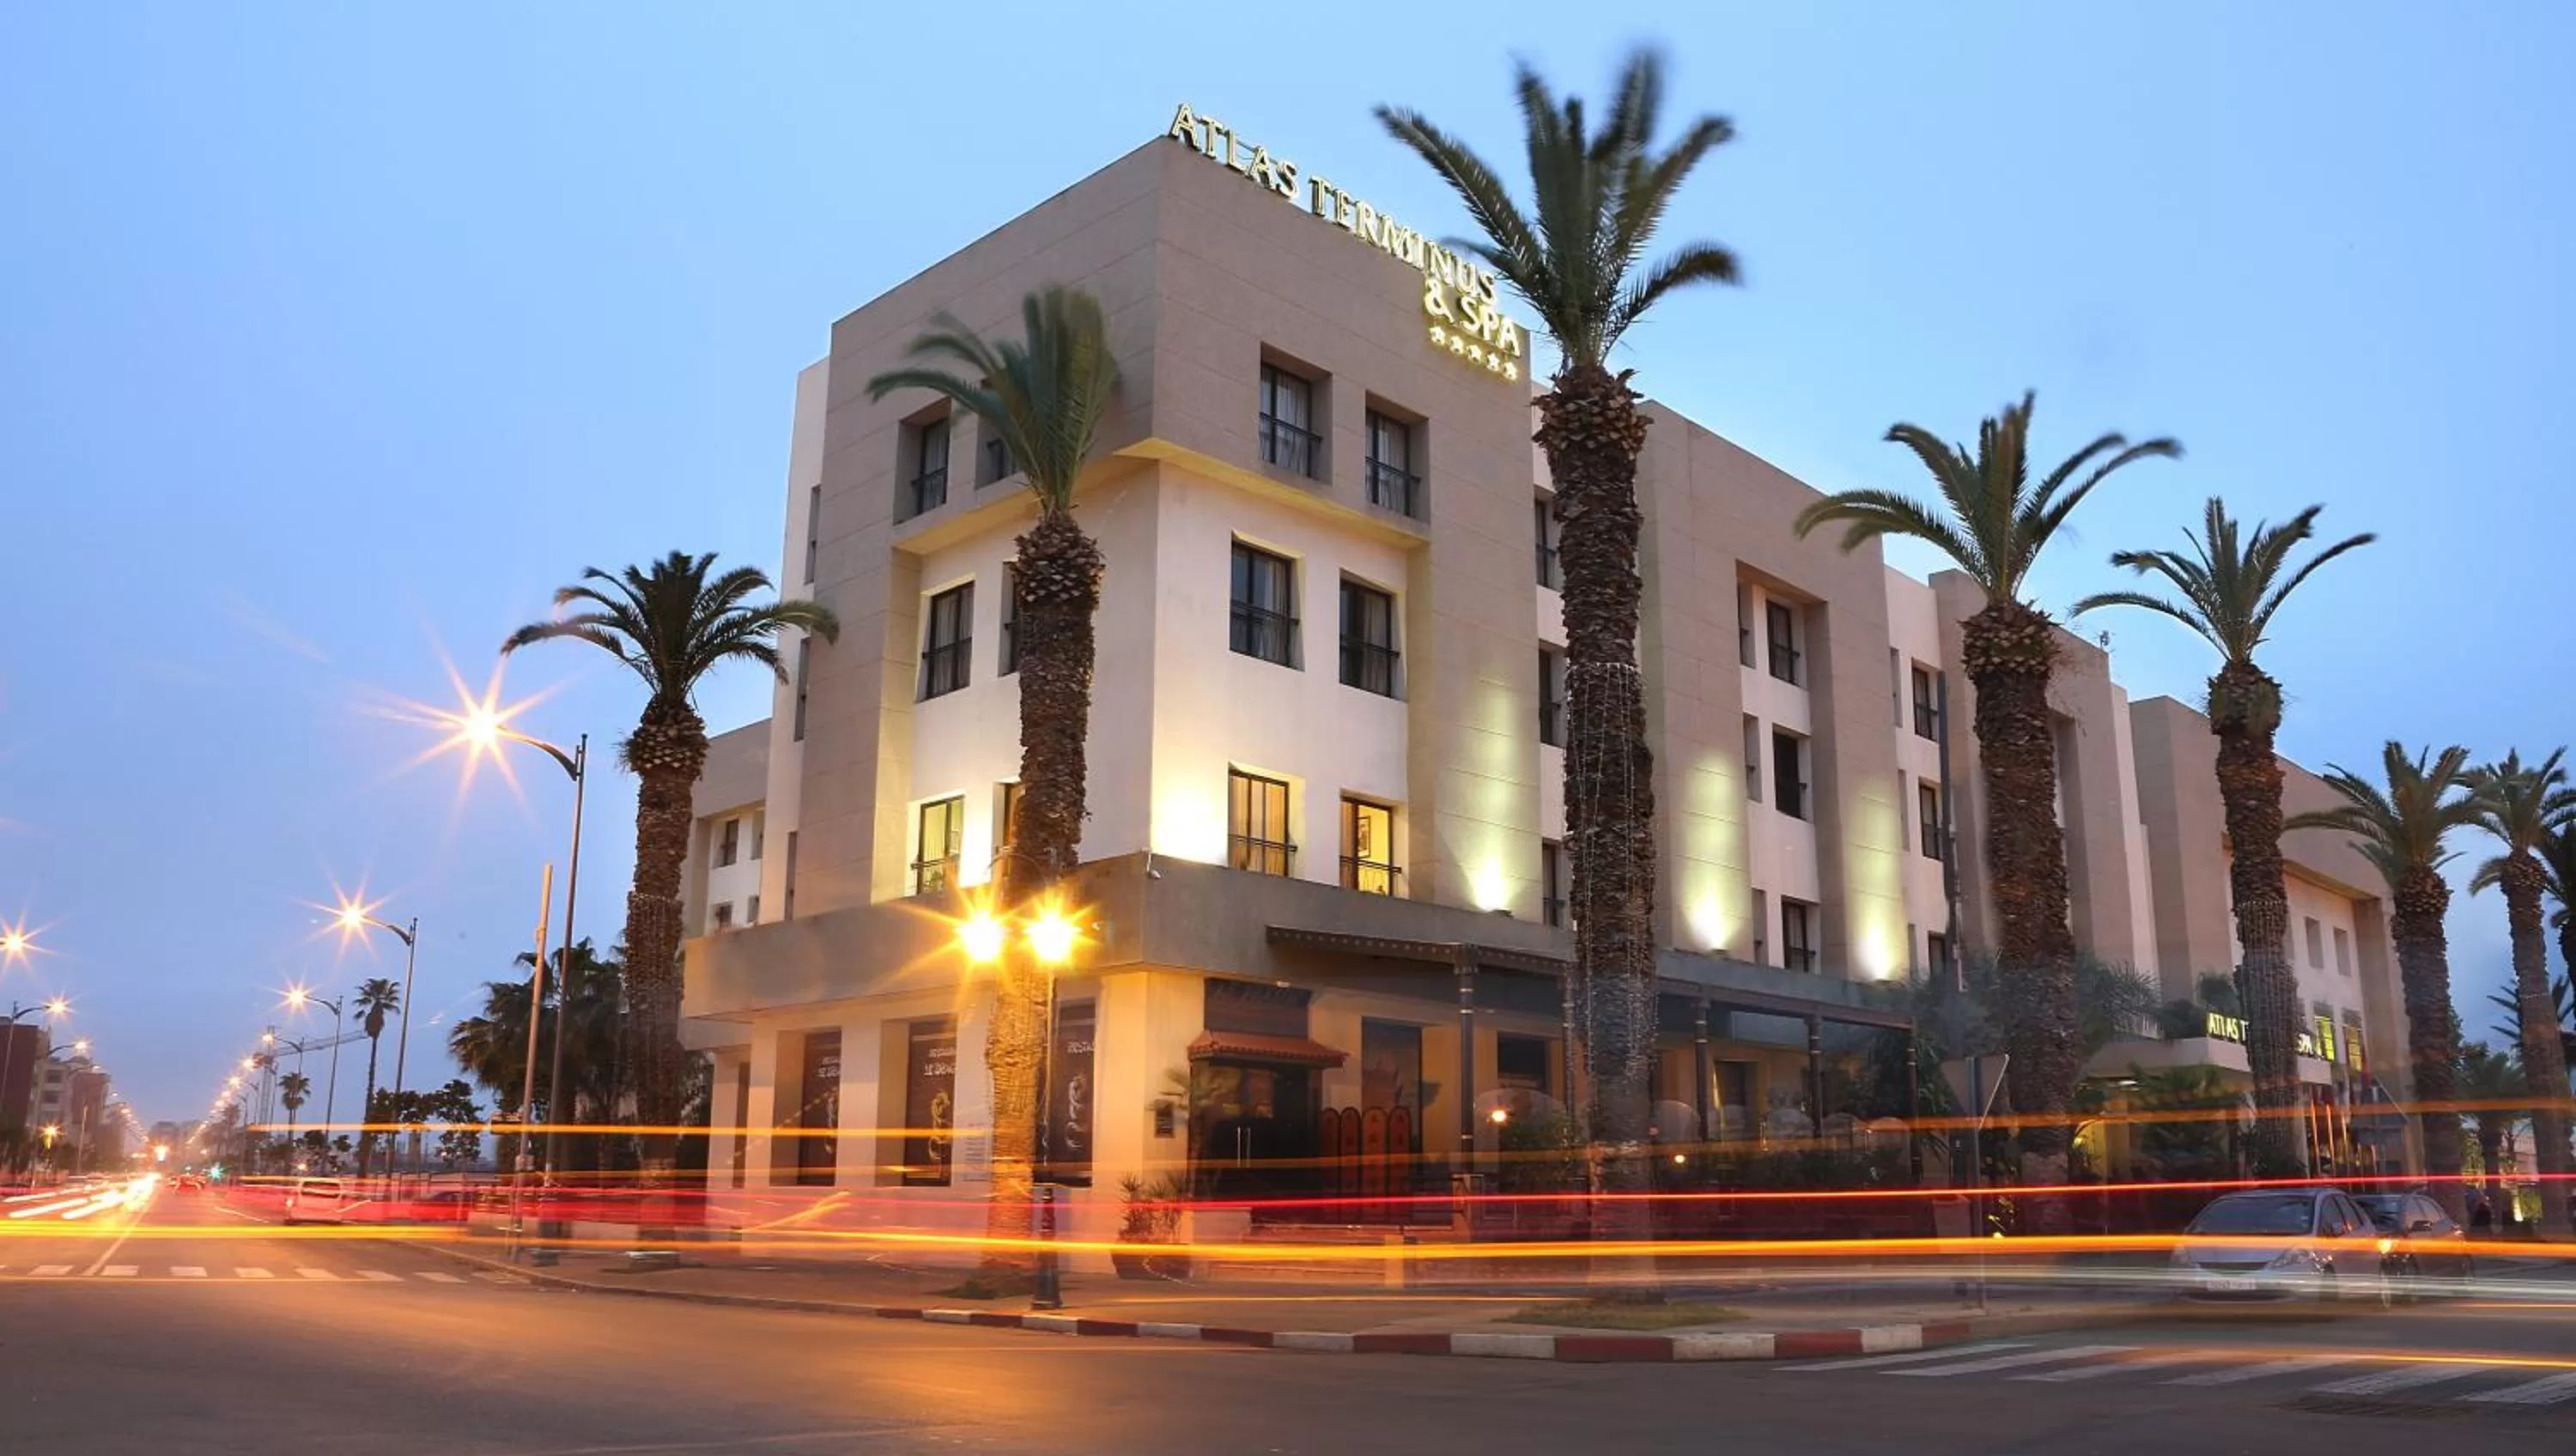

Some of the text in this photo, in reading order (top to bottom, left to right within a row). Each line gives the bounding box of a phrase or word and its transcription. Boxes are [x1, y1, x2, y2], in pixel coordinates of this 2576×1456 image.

[1168, 102, 1499, 307] ATLAS TERMINUS
[1423, 275, 1522, 358] & SPA
[2208, 1011, 2239, 1040] ATLAS
